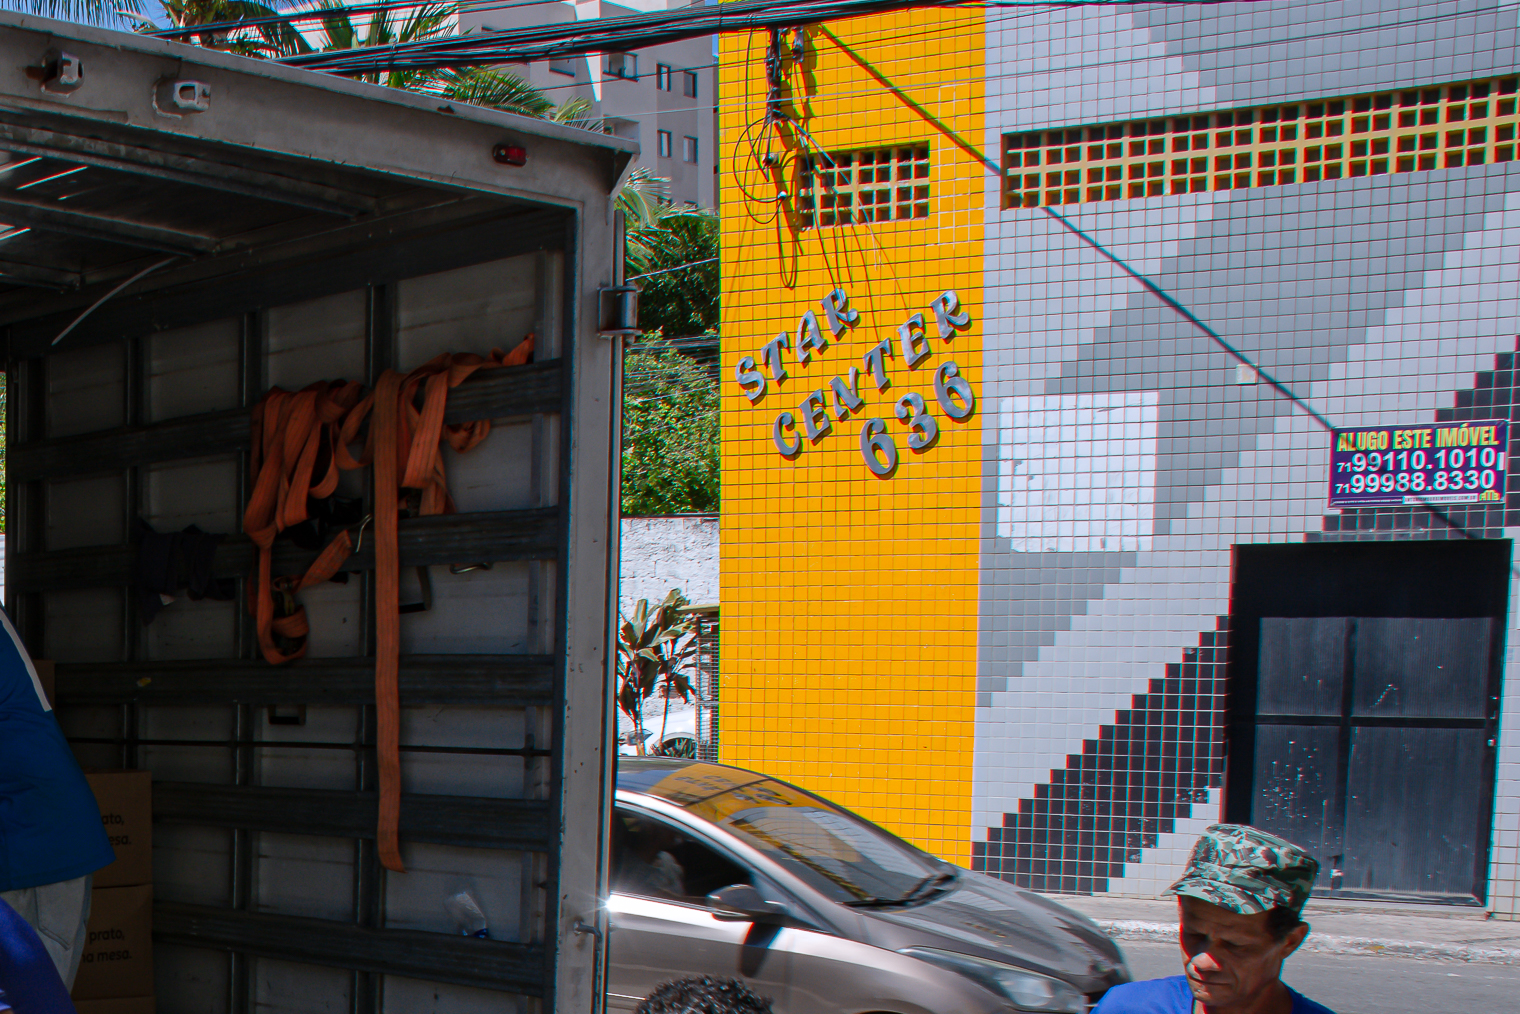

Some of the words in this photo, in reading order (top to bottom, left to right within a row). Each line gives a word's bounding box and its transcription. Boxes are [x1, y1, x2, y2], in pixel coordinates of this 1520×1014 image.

[735, 288, 859, 401] STAR
[773, 290, 970, 456] CENTER
[860, 361, 973, 475] 636
[1337, 430, 1389, 452] ALUGO
[1393, 429, 1432, 449] ESTE
[1435, 423, 1500, 448] IMÓVEL
[89, 927, 125, 945] prato,
[97, 948, 132, 962] mesa.
